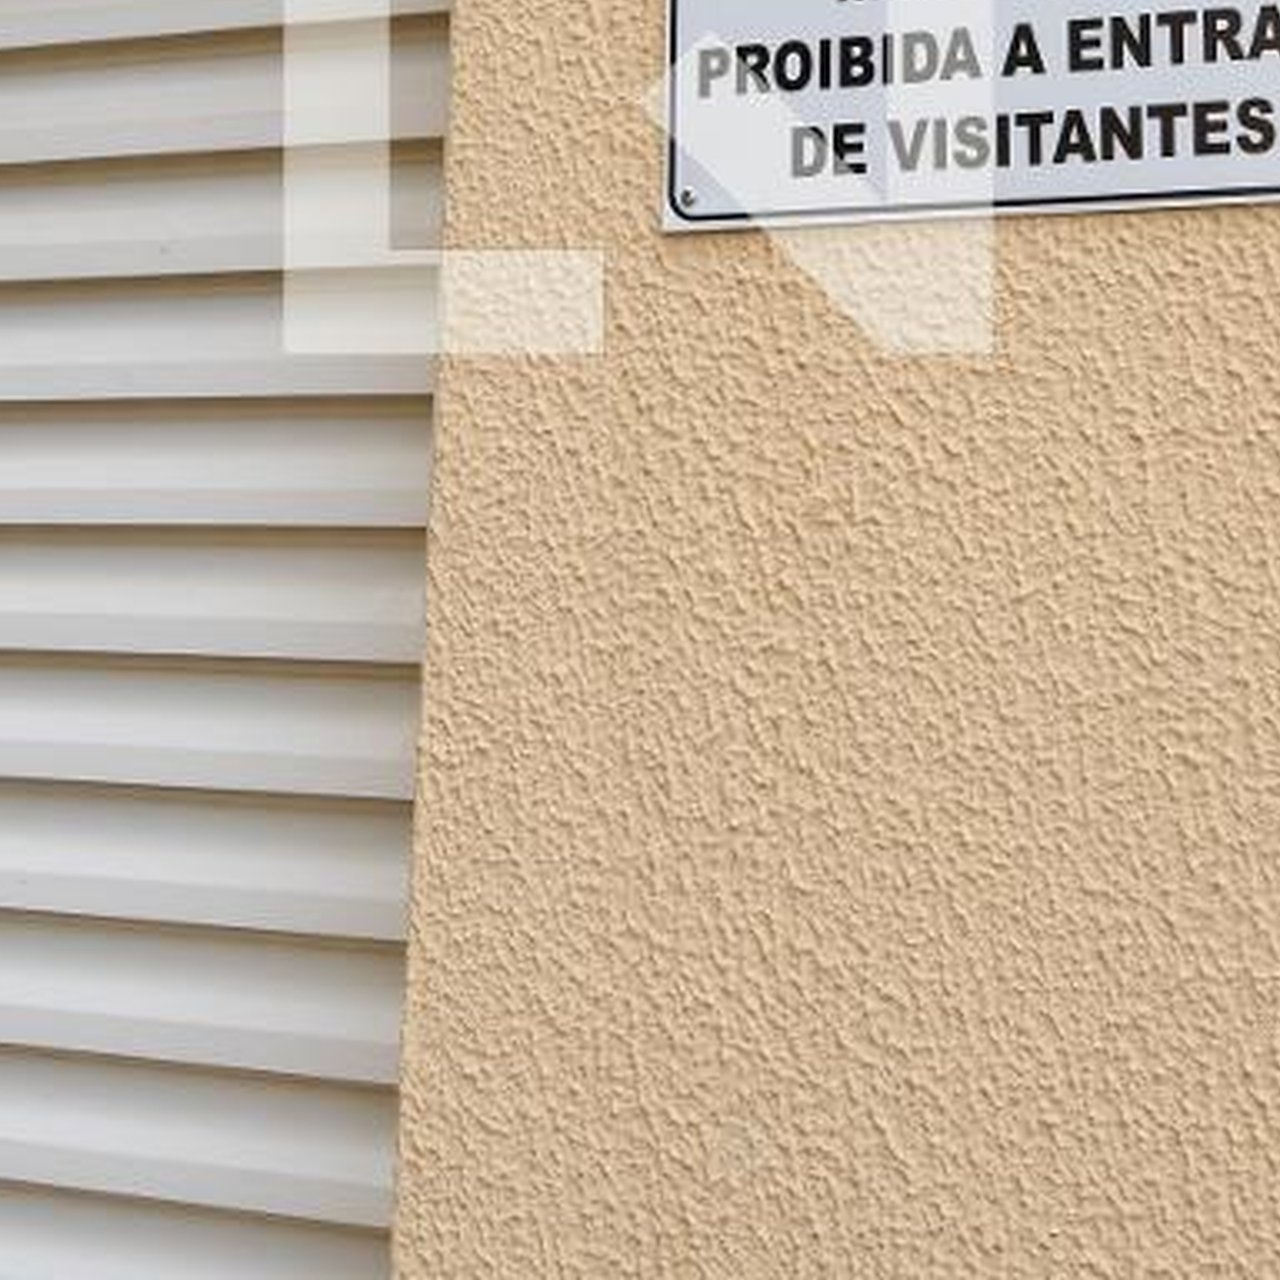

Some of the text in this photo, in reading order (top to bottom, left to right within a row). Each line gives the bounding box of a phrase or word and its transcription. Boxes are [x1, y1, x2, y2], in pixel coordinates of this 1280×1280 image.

[698, 27, 983, 99] PROIBIDA
[999, 21, 1048, 78] A
[790, 95, 1278, 179] DE VISITANTES
